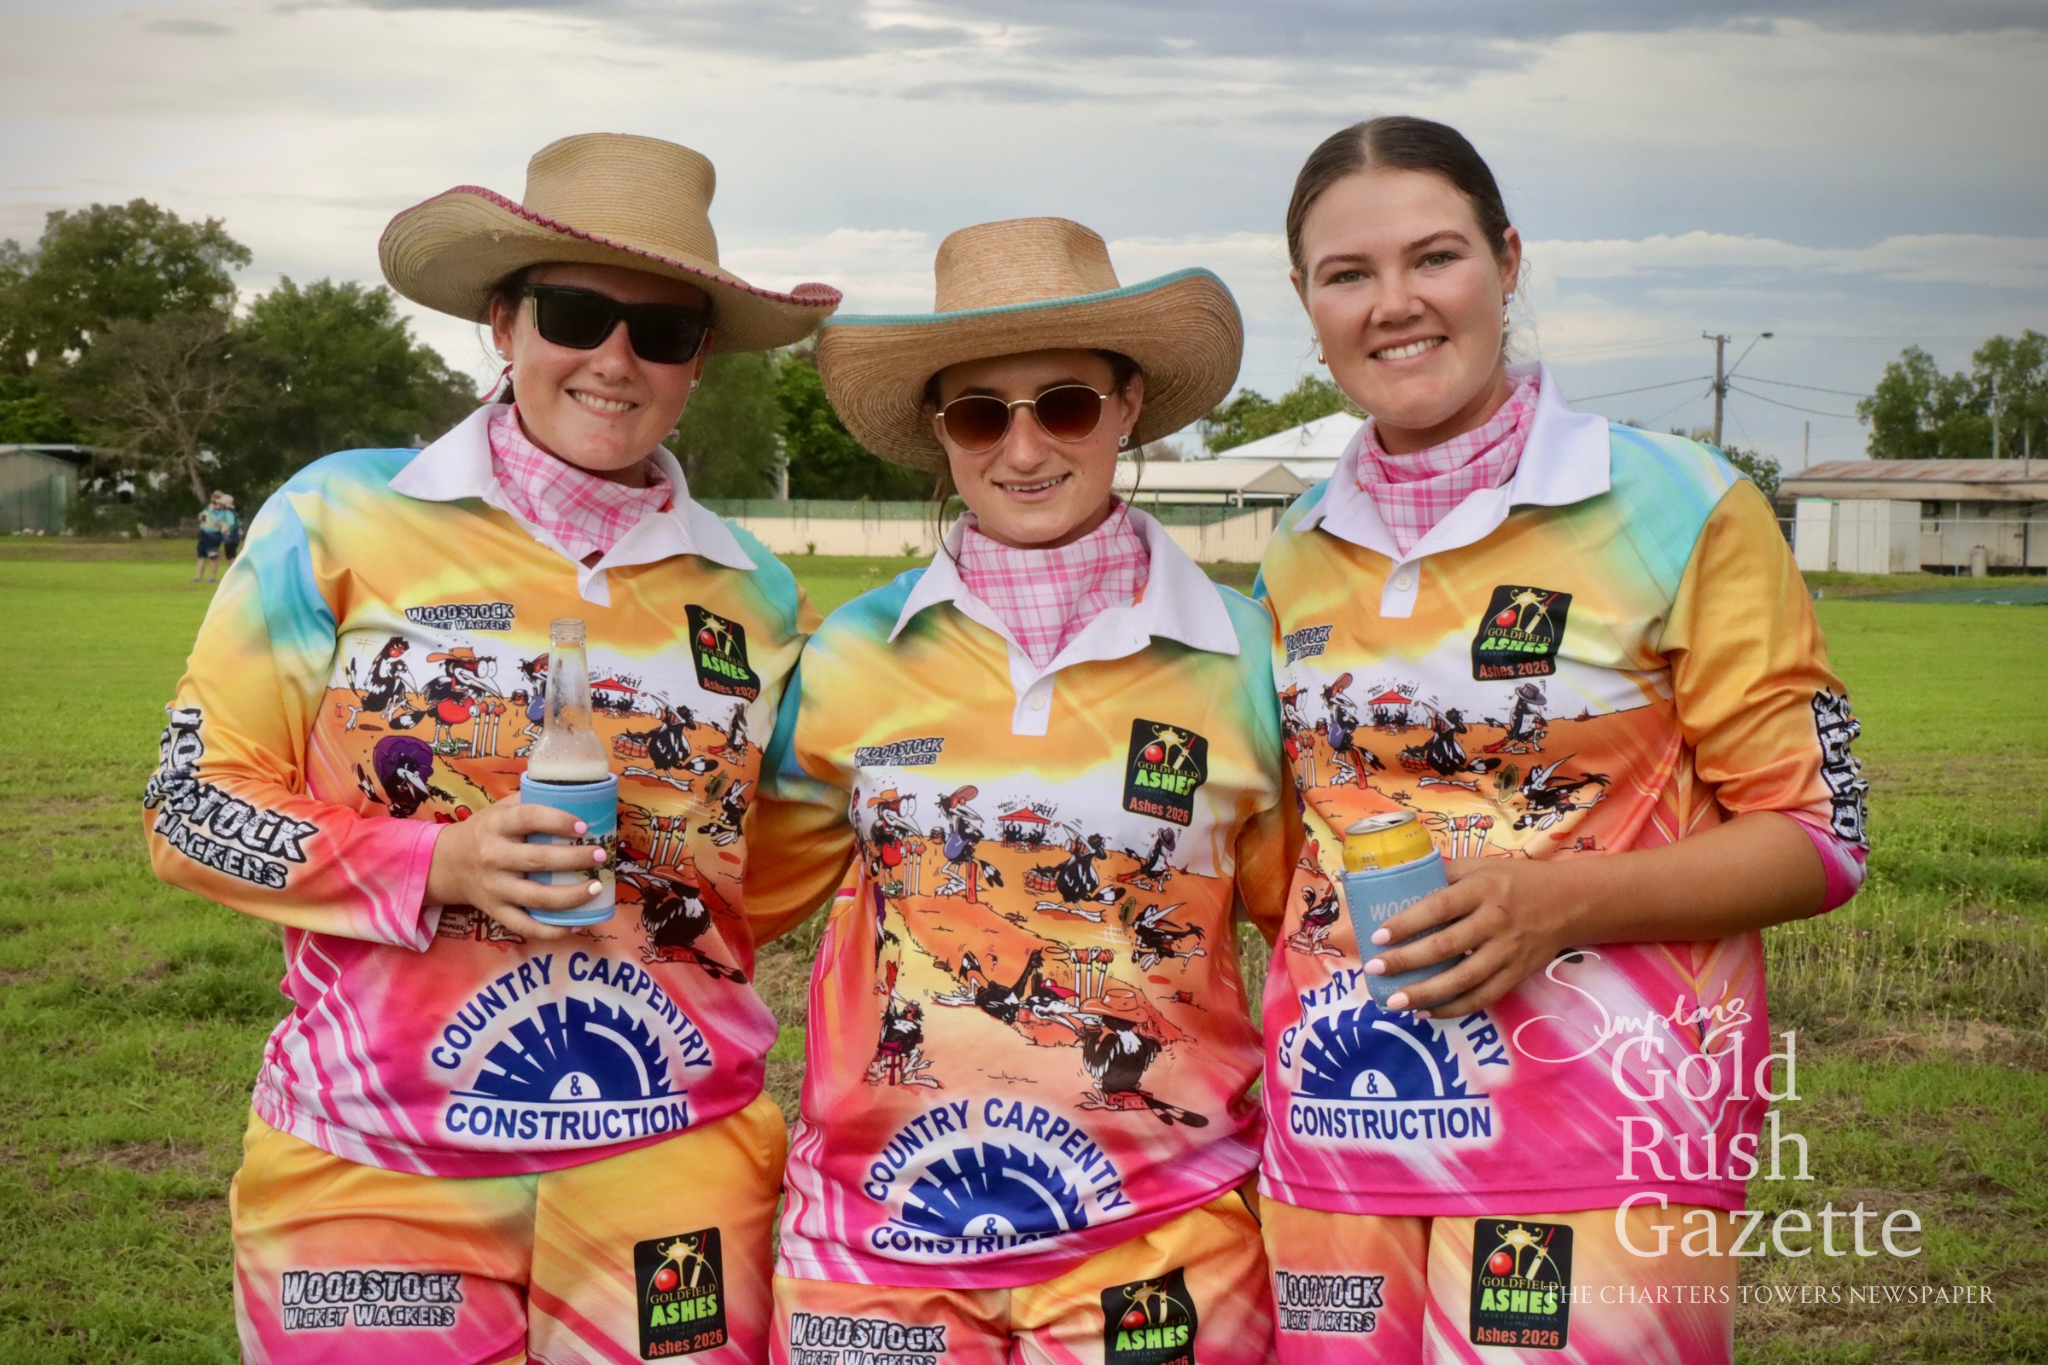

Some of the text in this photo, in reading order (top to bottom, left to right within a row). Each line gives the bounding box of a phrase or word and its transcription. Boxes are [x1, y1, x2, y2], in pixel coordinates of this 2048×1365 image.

[405, 602, 515, 622] WOODSTOCK
[455, 619, 512, 631] WACKERS
[1487, 627, 1551, 643] GOLDFIELD
[1480, 637, 1550, 655] ASHES
[702, 653, 749, 680] ASHES
[1480, 661, 1550, 678] Ashes 2026
[614, 673, 642, 689] YAH!
[704, 677, 732, 694] Ashes
[855, 737, 945, 758] WOODSTOCK
[889, 753, 937, 766] WACKERS
[1137, 760, 1199, 779] GOLDFIELD
[1134, 768, 1197, 796] ASHES
[1031, 801, 1058, 819] YAH!
[1129, 796, 1189, 823] Ashes 2026
[431, 951, 713, 1070] COUNTRY CARPENTRY
[570, 1074, 583, 1097] &
[1366, 1072, 1379, 1096] &
[445, 1101, 689, 1140] CONSTRUCTION
[1290, 1104, 1492, 1141] CONSTRUCTION
[864, 1097, 1132, 1213] COUNTRY CARPENTRY
[983, 1216, 998, 1236] &
[871, 1226, 1066, 1255] CONSTRU
[282, 1270, 464, 1306] WOODSTOCK
[650, 1283, 717, 1305] GOLDFIELD
[1275, 1270, 1385, 1309] WOODSTOCK
[1482, 1276, 1559, 1291] GOLDFIELD
[650, 1293, 718, 1327] ASHES
[1480, 1288, 1558, 1315] ASHES
[284, 1303, 456, 1330] WICKET WACKERS
[1311, 1308, 1376, 1333] WACKERS
[648, 1339, 690, 1357] Ashes
[694, 1328, 723, 1349] 2026
[791, 1313, 946, 1353] WOODSTOCK
[1115, 1325, 1189, 1352] ASHES
[1476, 1326, 1559, 1347] Ashes 2026
